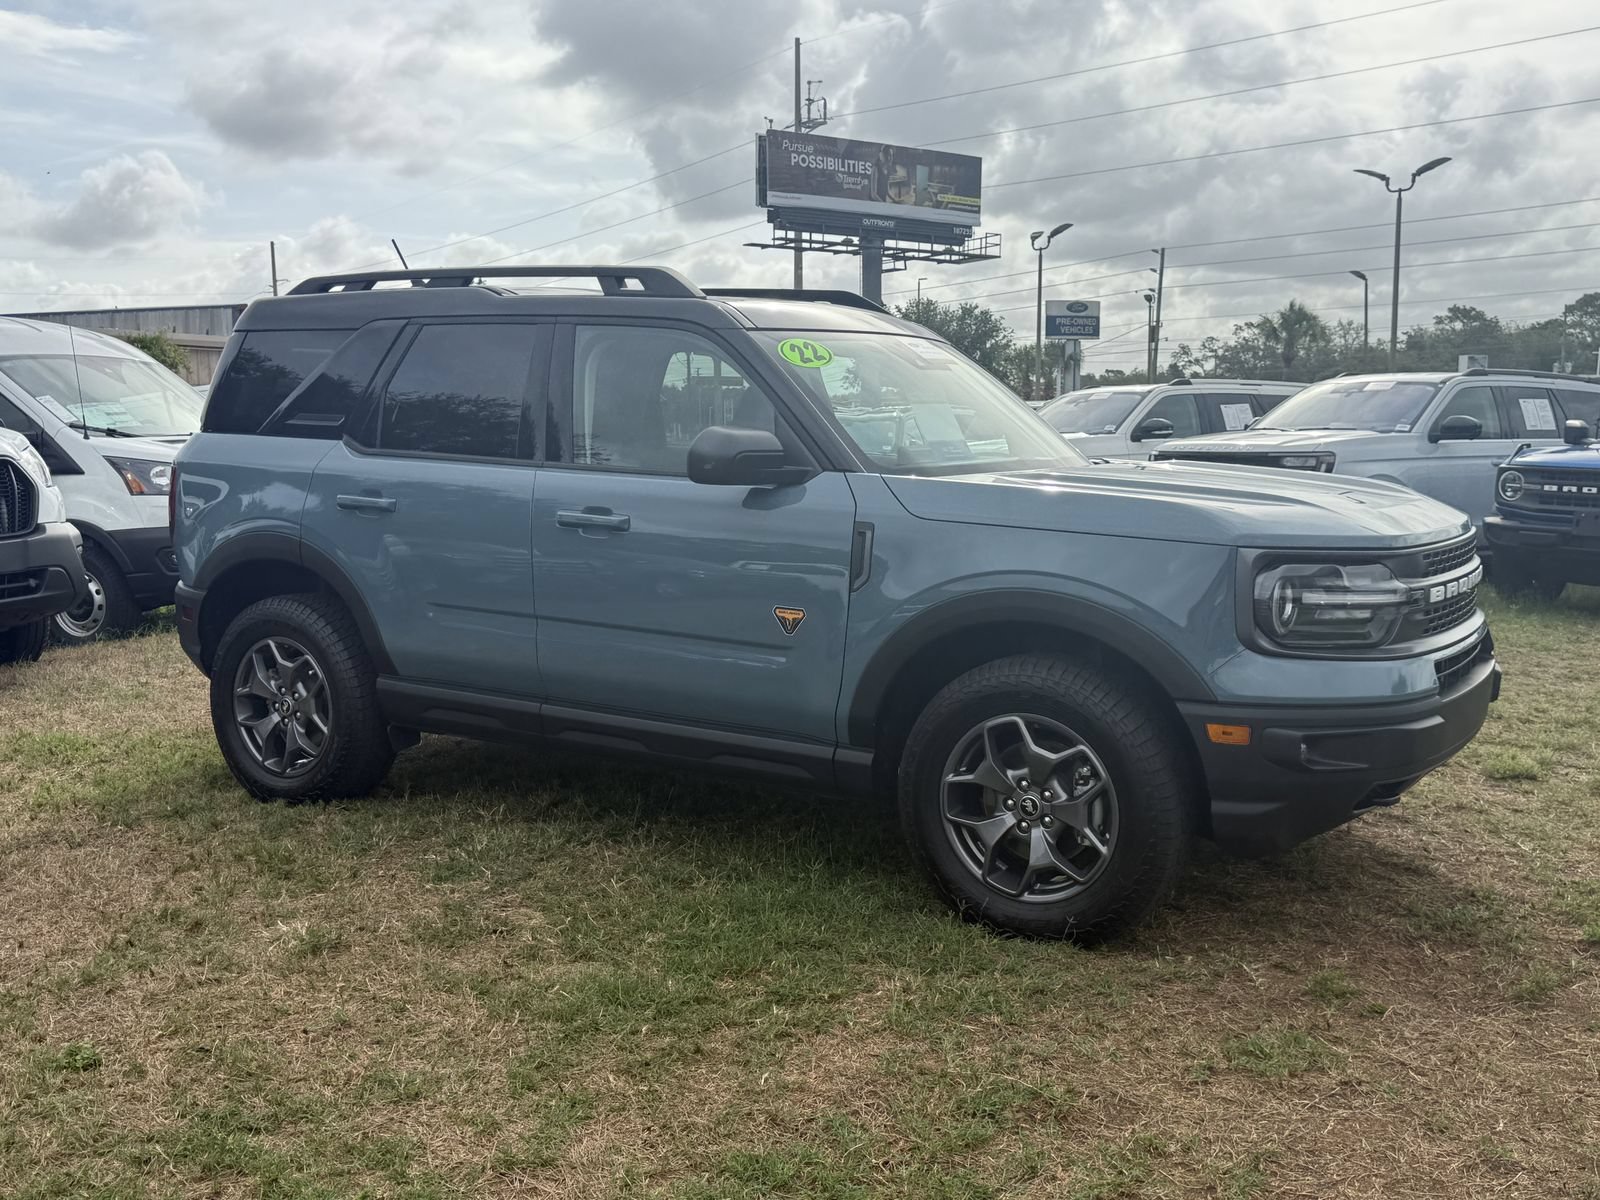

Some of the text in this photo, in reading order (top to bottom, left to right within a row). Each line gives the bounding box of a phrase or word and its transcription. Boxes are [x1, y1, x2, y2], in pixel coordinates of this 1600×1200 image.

[782, 139, 814, 153] Pursue
[791, 153, 872, 174] POSSIBILITIES
[1055, 317, 1096, 326] PRE-OWNED
[1060, 326, 1093, 334] VEHICLES
[789, 341, 828, 364] 22
